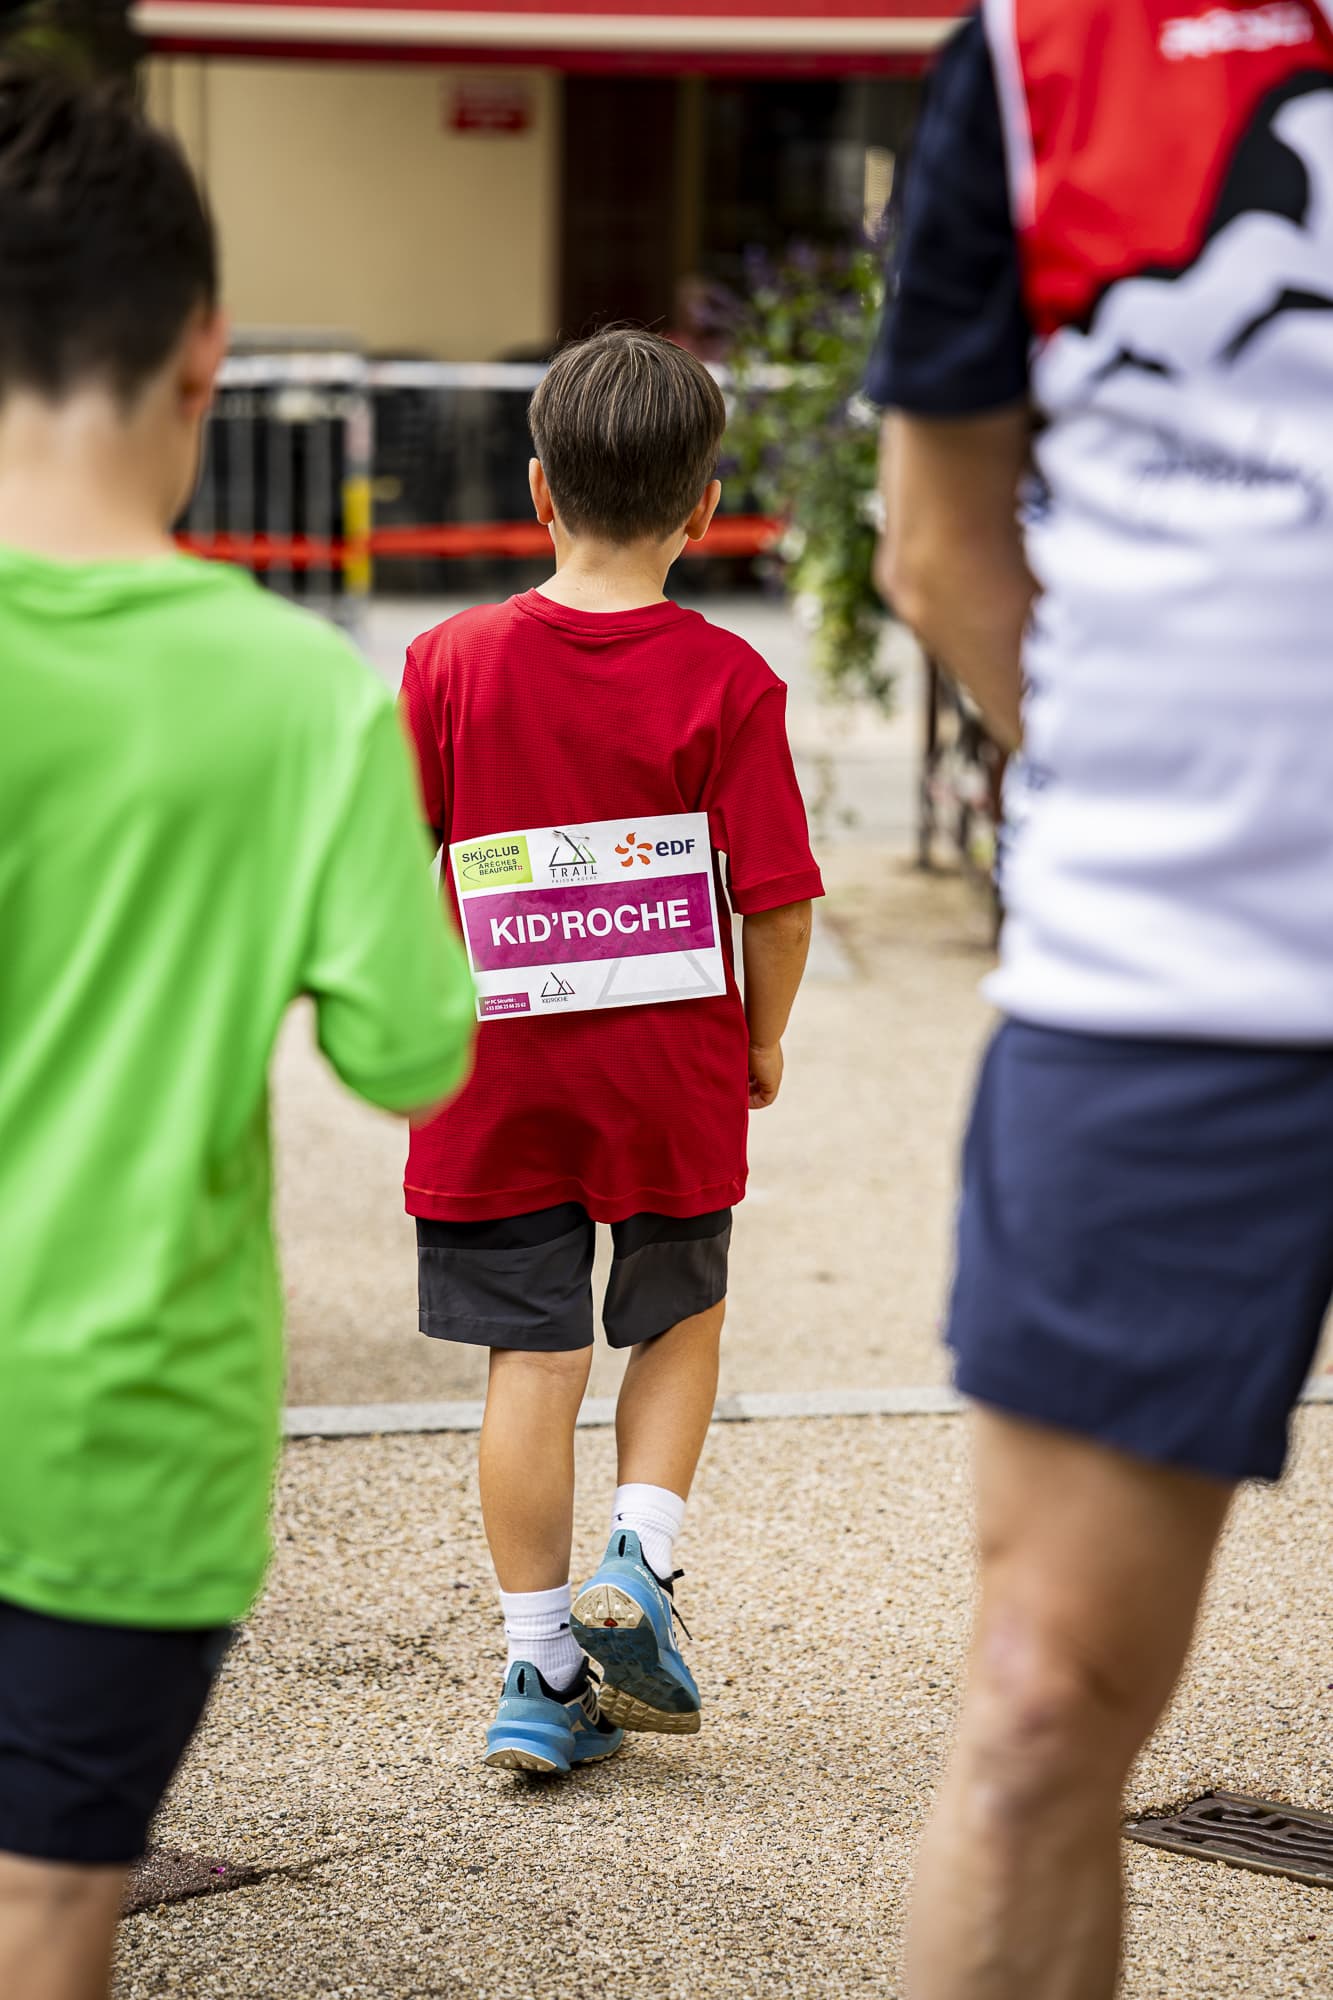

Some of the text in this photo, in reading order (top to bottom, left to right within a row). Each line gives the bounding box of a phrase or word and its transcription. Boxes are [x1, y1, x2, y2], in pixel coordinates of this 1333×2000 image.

[486, 845, 520, 859] CLUB
[479, 865, 518, 876] BEAUFORT
[549, 865, 598, 878] TRAIL
[489, 898, 691, 947] KID'ROCHE
